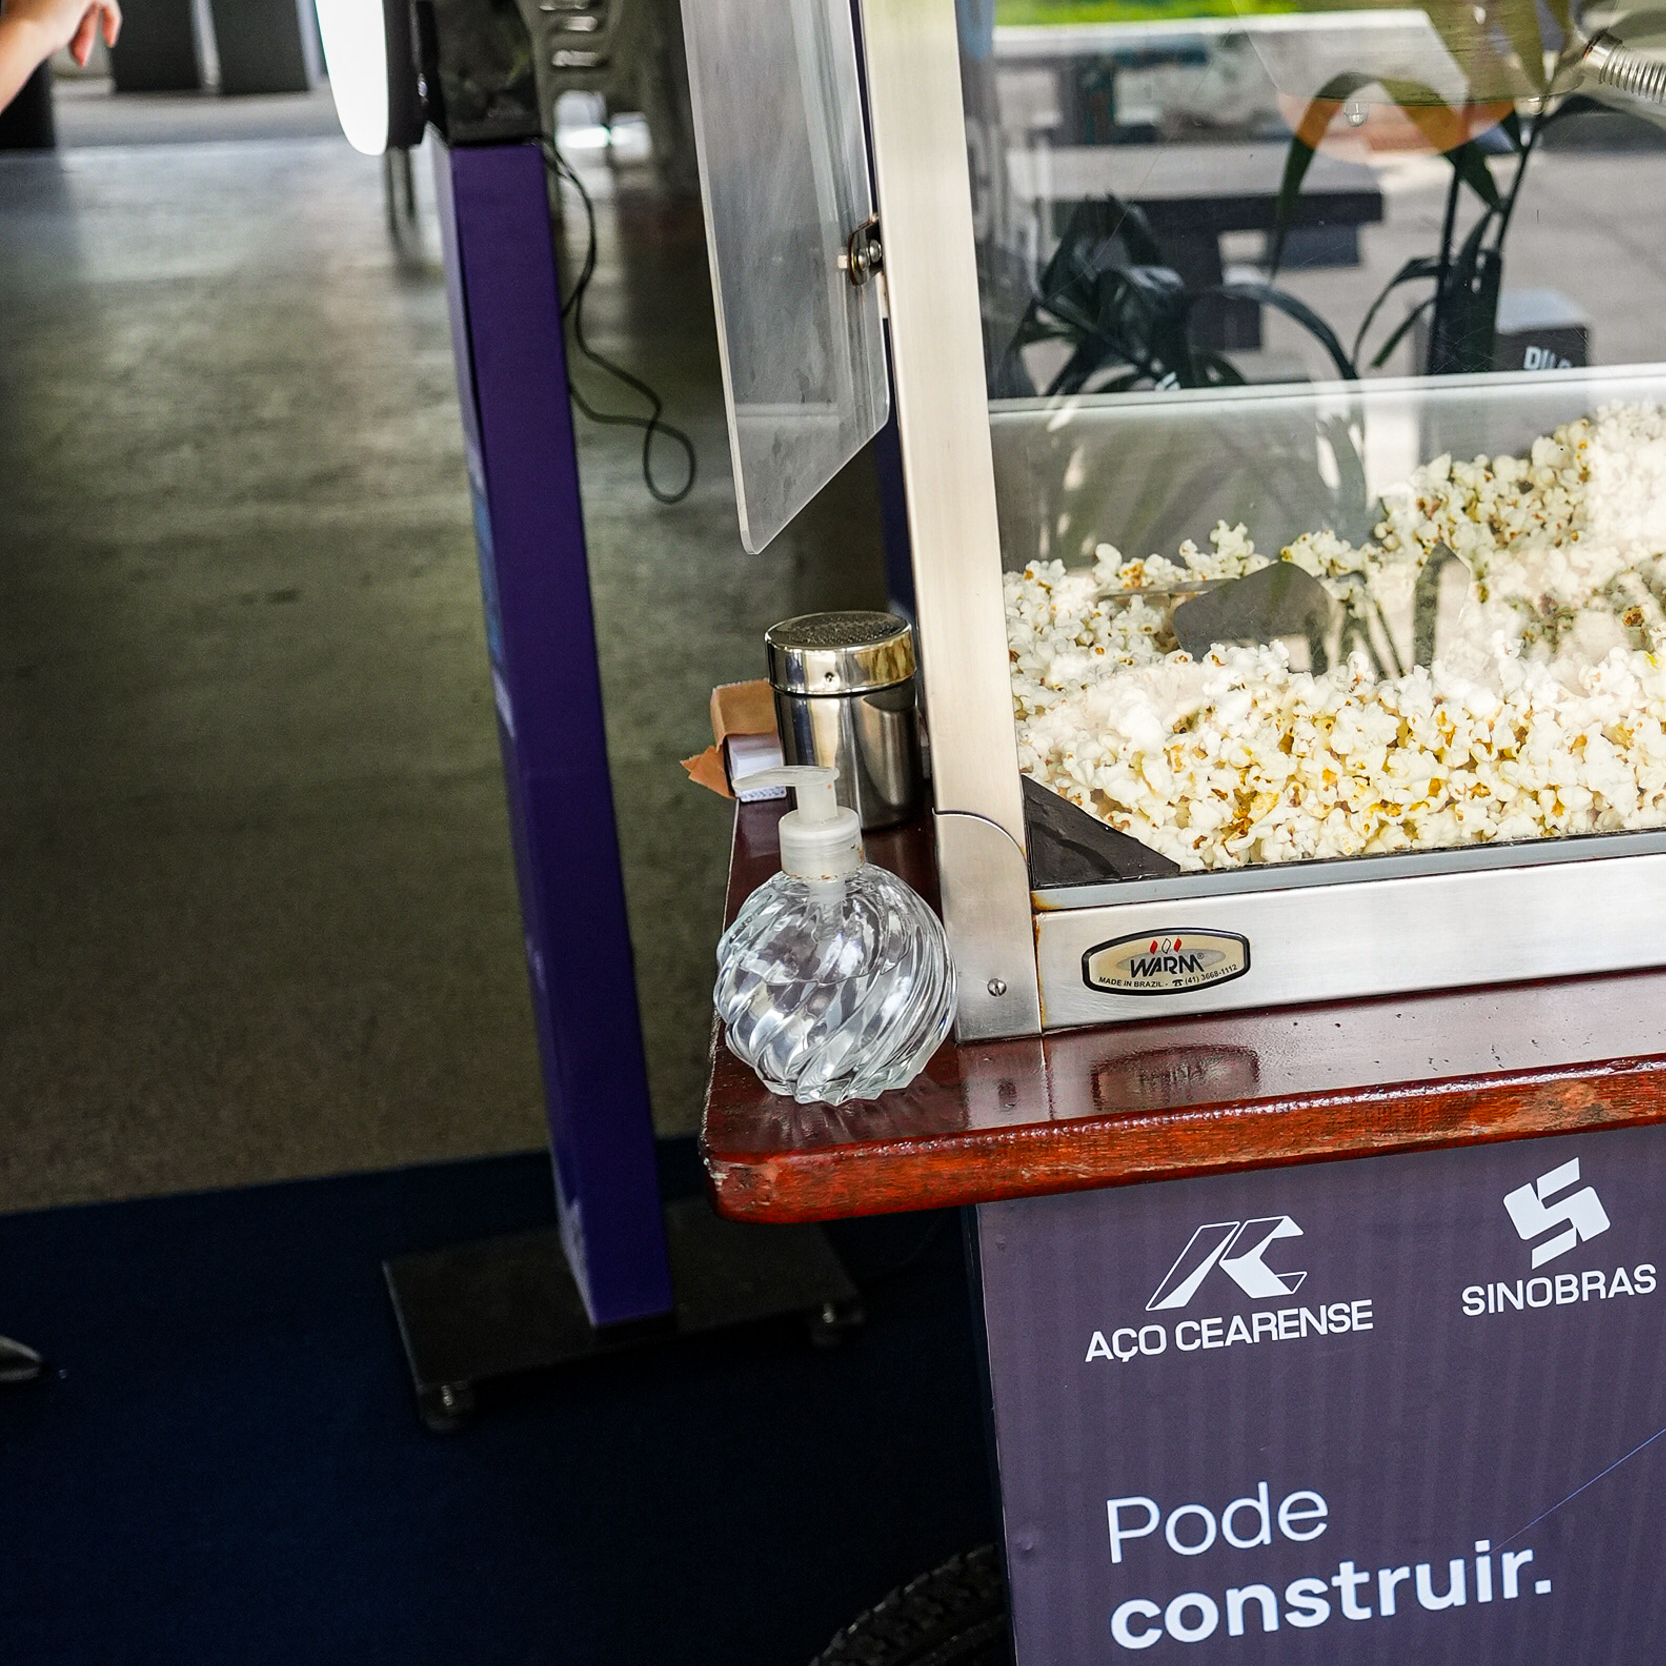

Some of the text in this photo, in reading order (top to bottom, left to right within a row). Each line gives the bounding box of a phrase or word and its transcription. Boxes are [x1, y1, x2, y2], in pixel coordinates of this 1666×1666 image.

[1099, 976, 1121, 986] MADE
[1134, 980, 1163, 988] BRAZIL
[1185, 976, 1199, 985] (41)
[1130, 954, 1204, 978] WARM
[1462, 1264, 1657, 1317] SINOBRAS
[1085, 1299, 1374, 1363] AÇO CEARENSE
[1106, 1481, 1328, 1564] Pode
[1110, 1539, 1553, 1650] construir.
